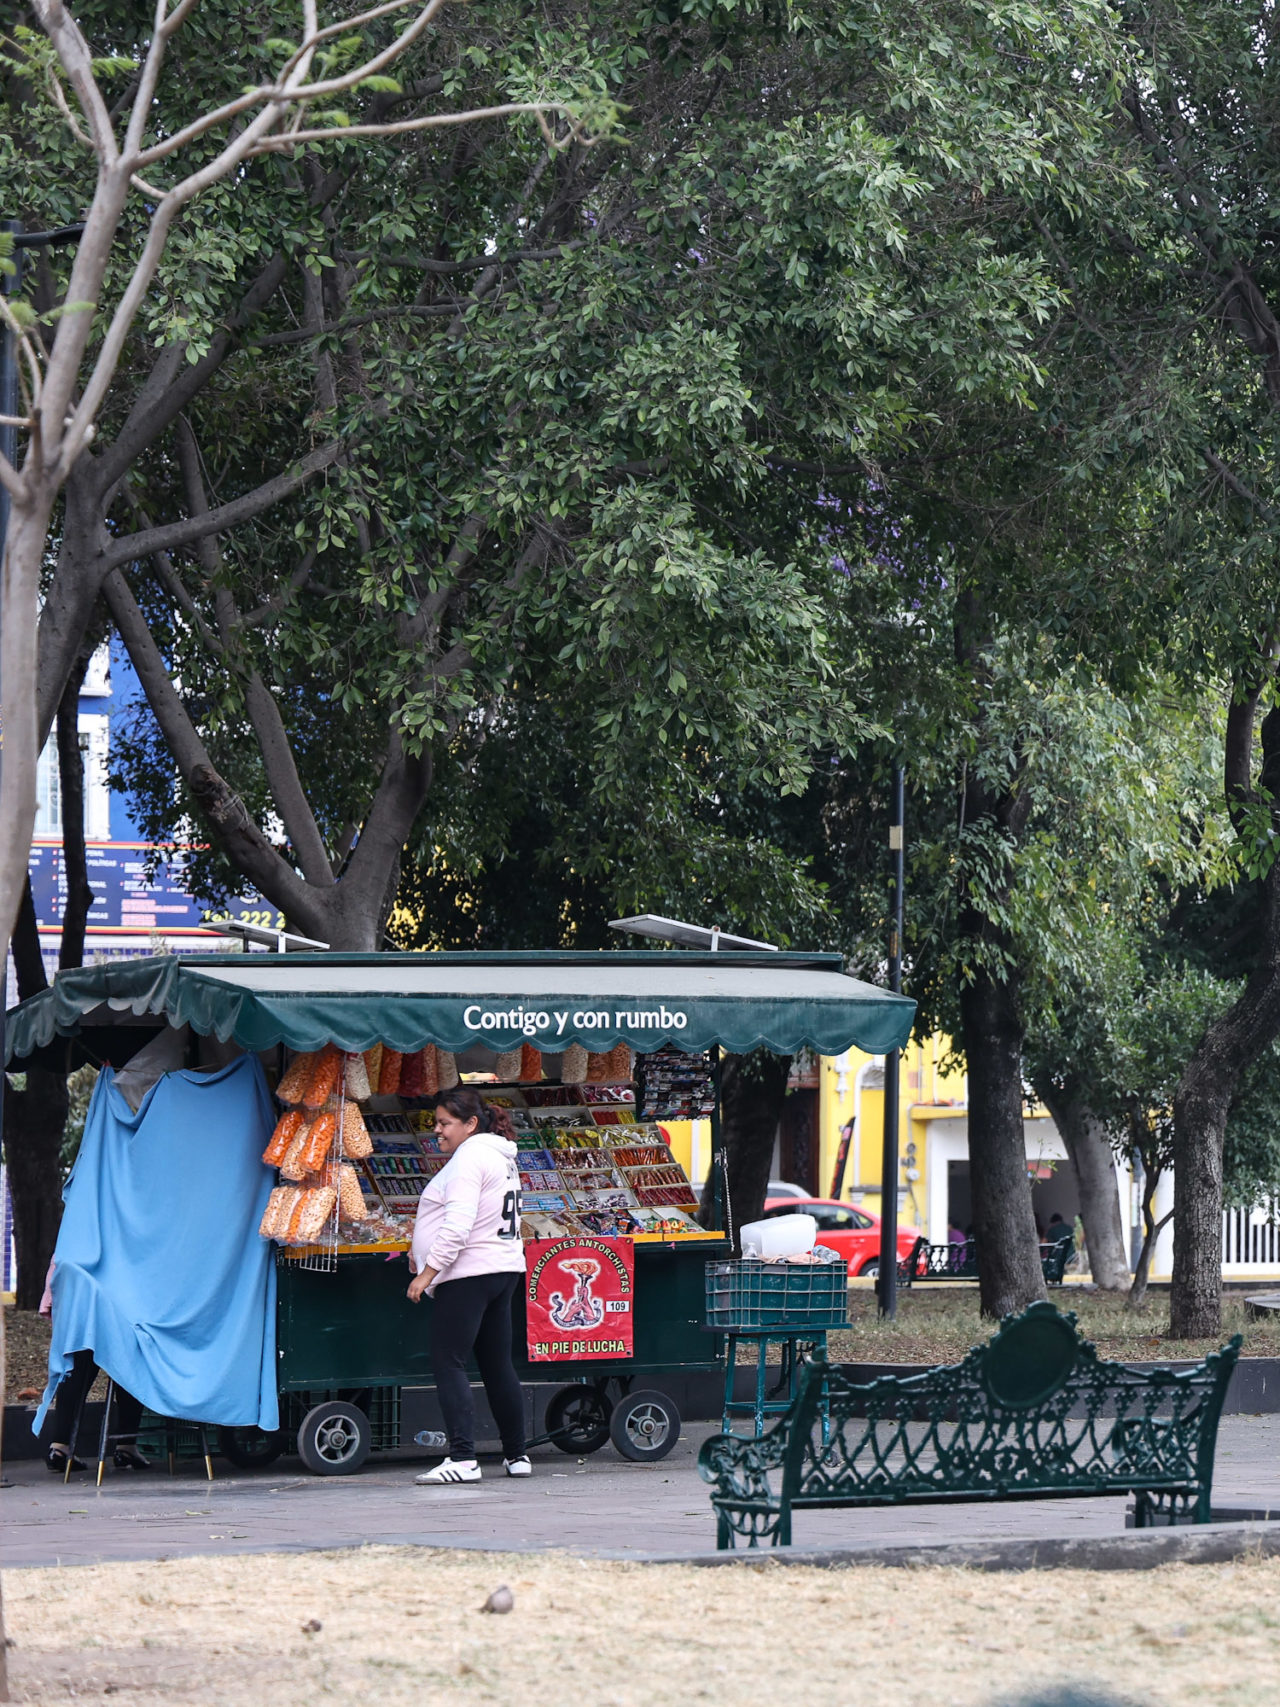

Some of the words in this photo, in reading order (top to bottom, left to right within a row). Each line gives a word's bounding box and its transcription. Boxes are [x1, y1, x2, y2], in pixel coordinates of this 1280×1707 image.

[463, 1005, 549, 1036] Contigo
[553, 1010, 569, 1036] y
[573, 1010, 610, 1029] con
[615, 1005, 688, 1029] rumbo
[529, 1239, 576, 1301] COMERCIANTES
[579, 1239, 630, 1293] ANTORCHISTAS
[610, 1302, 626, 1311] 109
[535, 1343, 549, 1354] EN
[552, 1342, 570, 1354] PIE
[572, 1341, 586, 1353] DE
[588, 1340, 625, 1353] LUCHA
